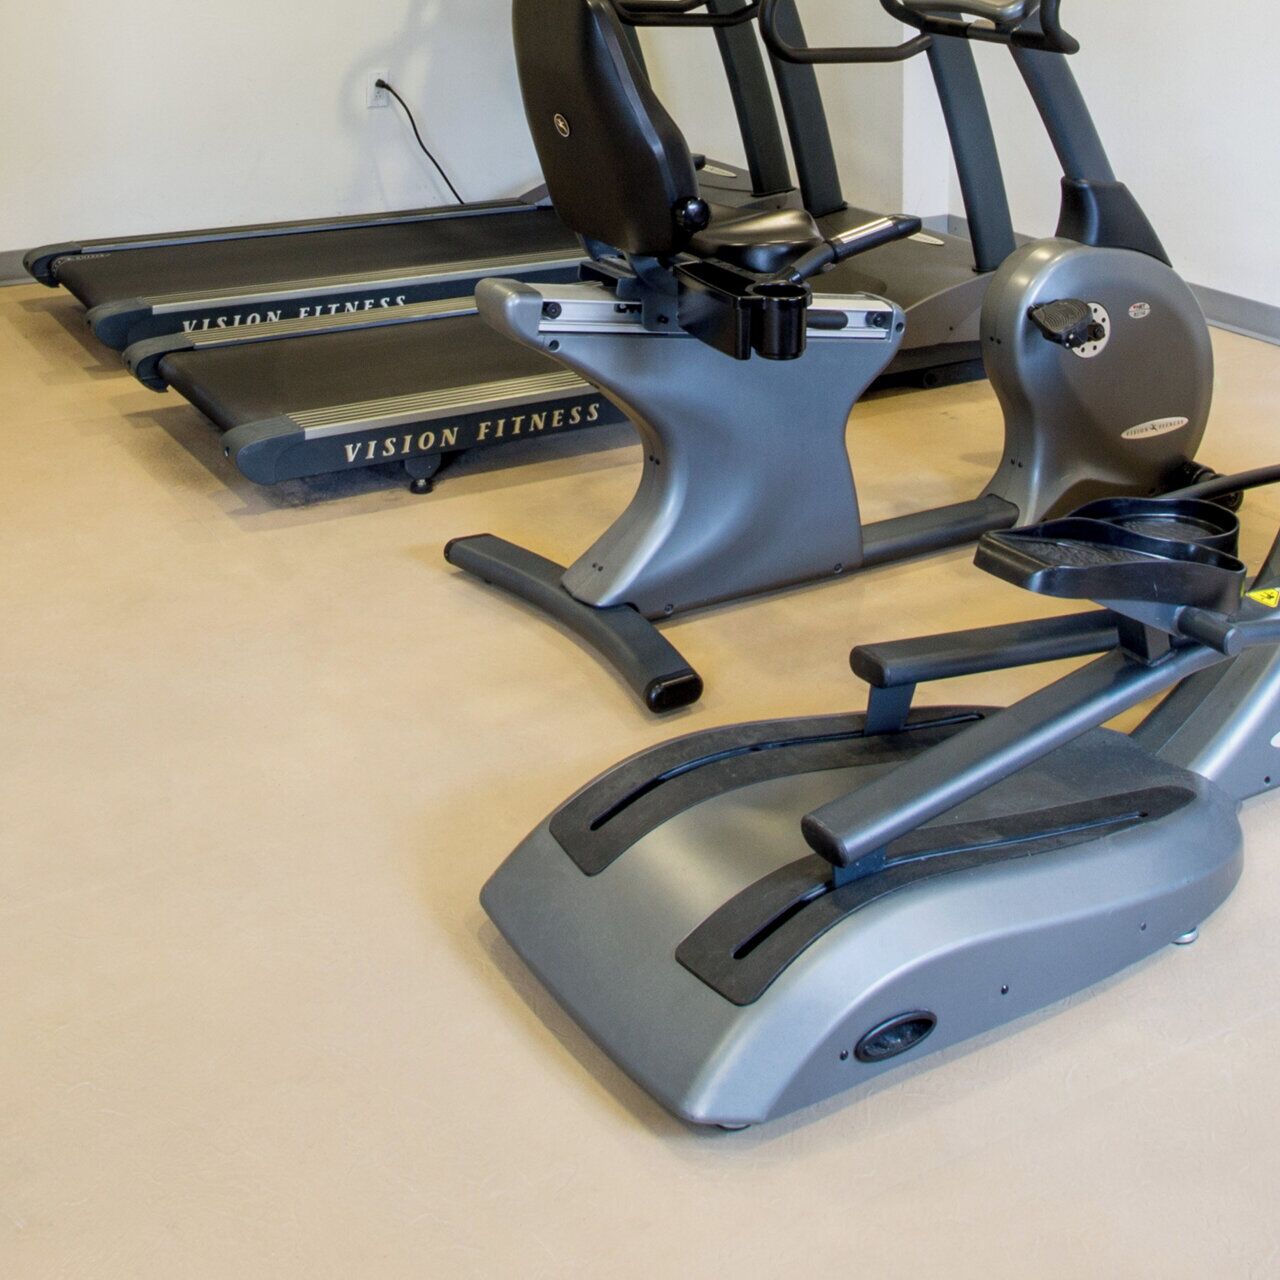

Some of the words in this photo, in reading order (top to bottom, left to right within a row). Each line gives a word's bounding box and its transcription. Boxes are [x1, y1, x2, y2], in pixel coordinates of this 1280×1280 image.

[182, 309, 282, 333] VISION
[299, 295, 407, 319] FITNESS
[345, 426, 460, 463] VISION
[476, 402, 600, 441] FITNESS
